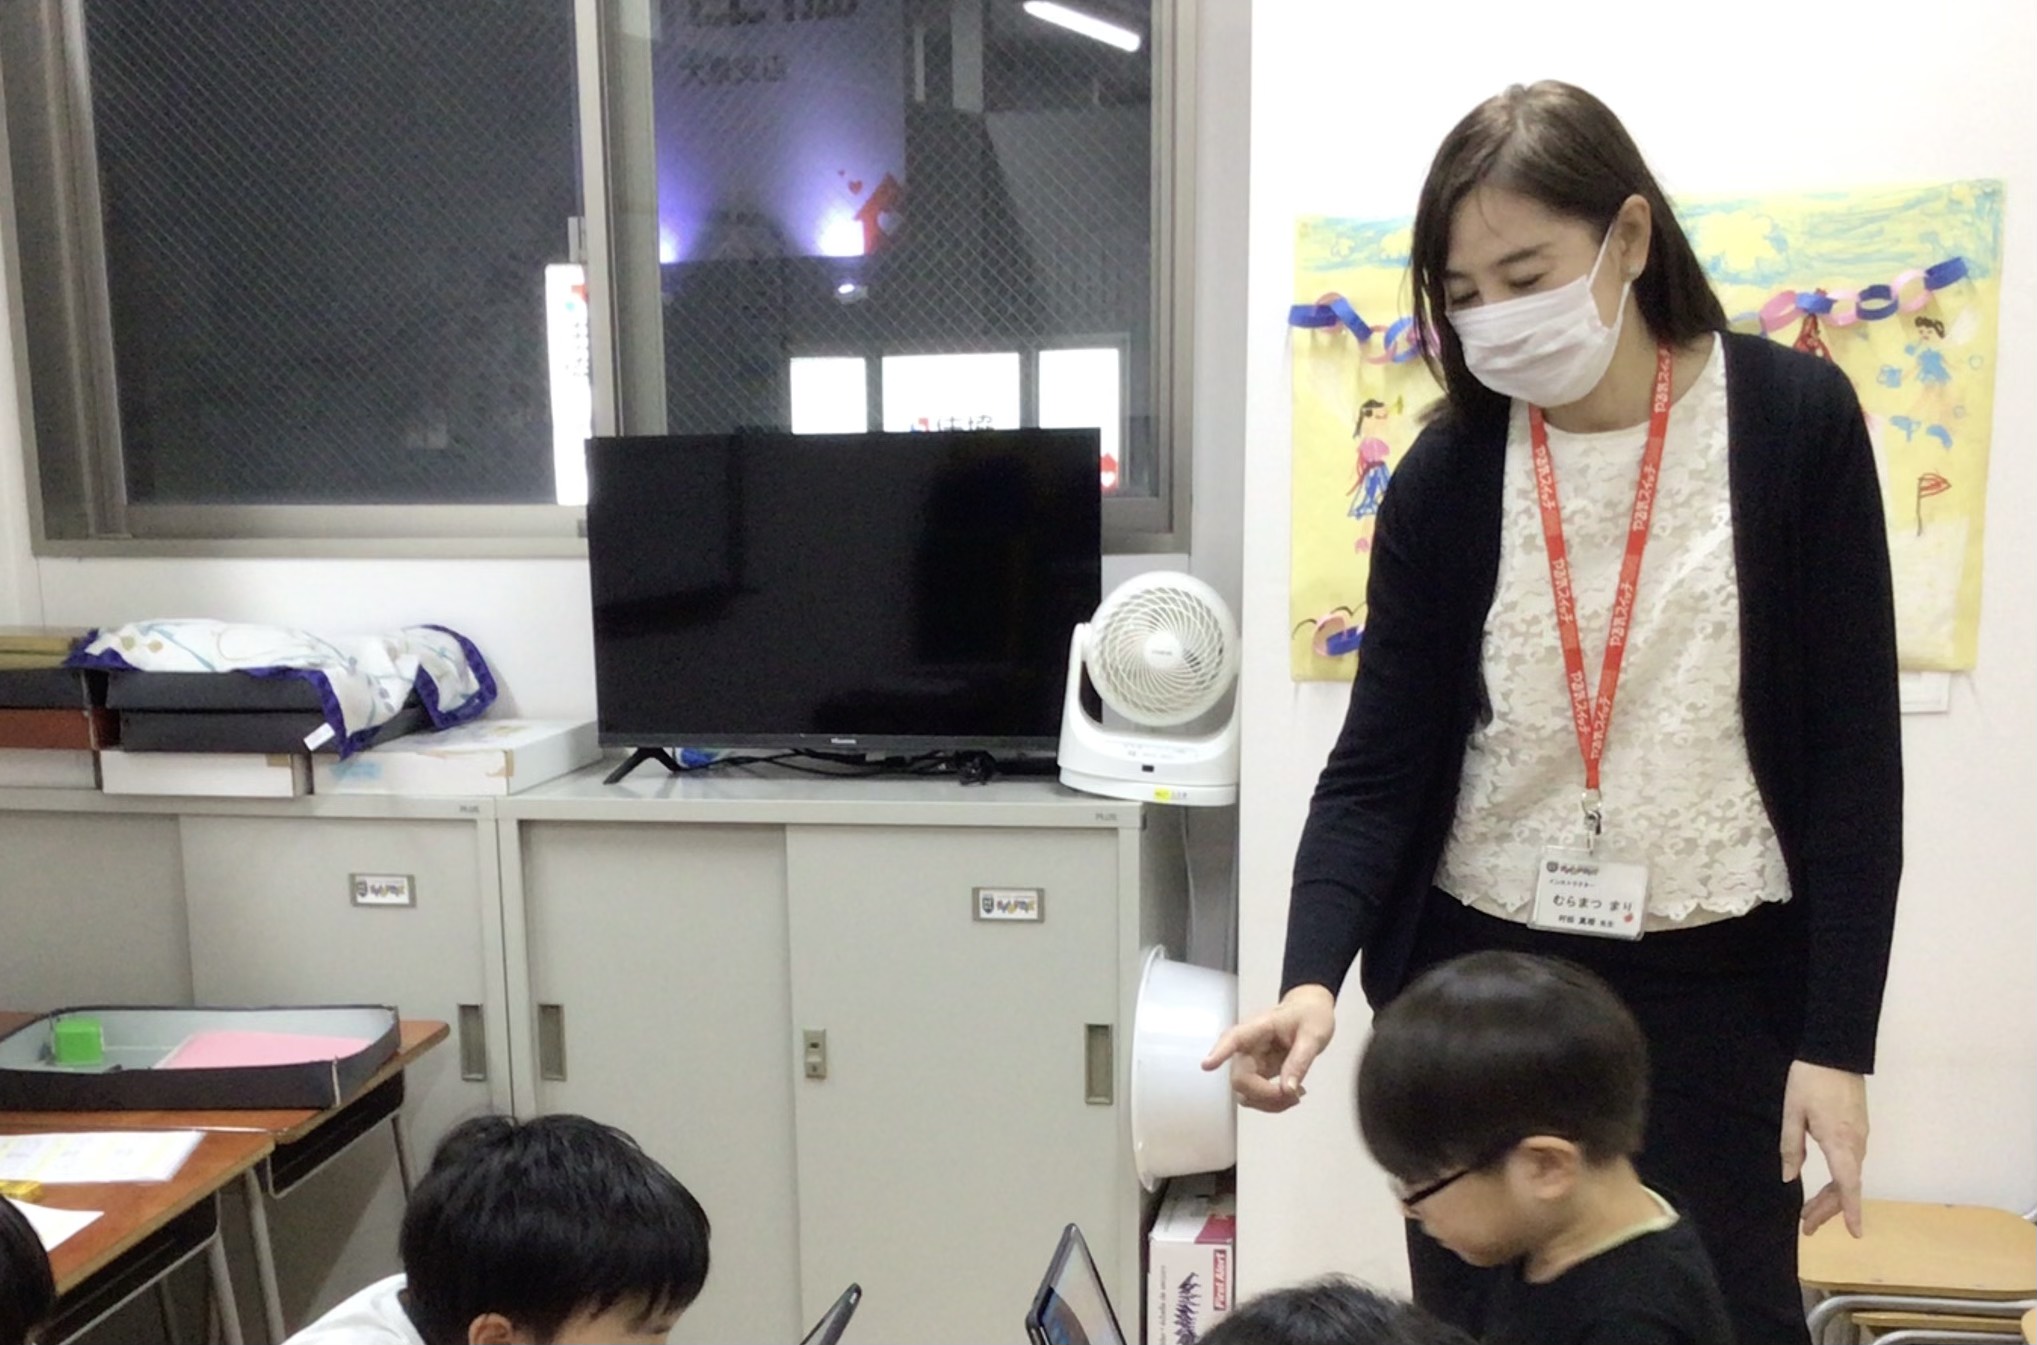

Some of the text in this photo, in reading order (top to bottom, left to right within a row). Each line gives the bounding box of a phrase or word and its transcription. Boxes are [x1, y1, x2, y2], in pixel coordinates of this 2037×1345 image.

[1534, 445, 1557, 511] やる気スイッチ
[1632, 463, 1658, 532] やる気スイッチ
[1551, 558, 1574, 624] やる気スイッチ
[1609, 582, 1635, 647] やる気スイッチ
[1570, 671, 1591, 736] やる気スイッチ
[1589, 696, 1612, 760] やる気スイッチ
[1553, 894, 1633, 913] むらまつ まり
[1214, 1251, 1226, 1281] Alert
